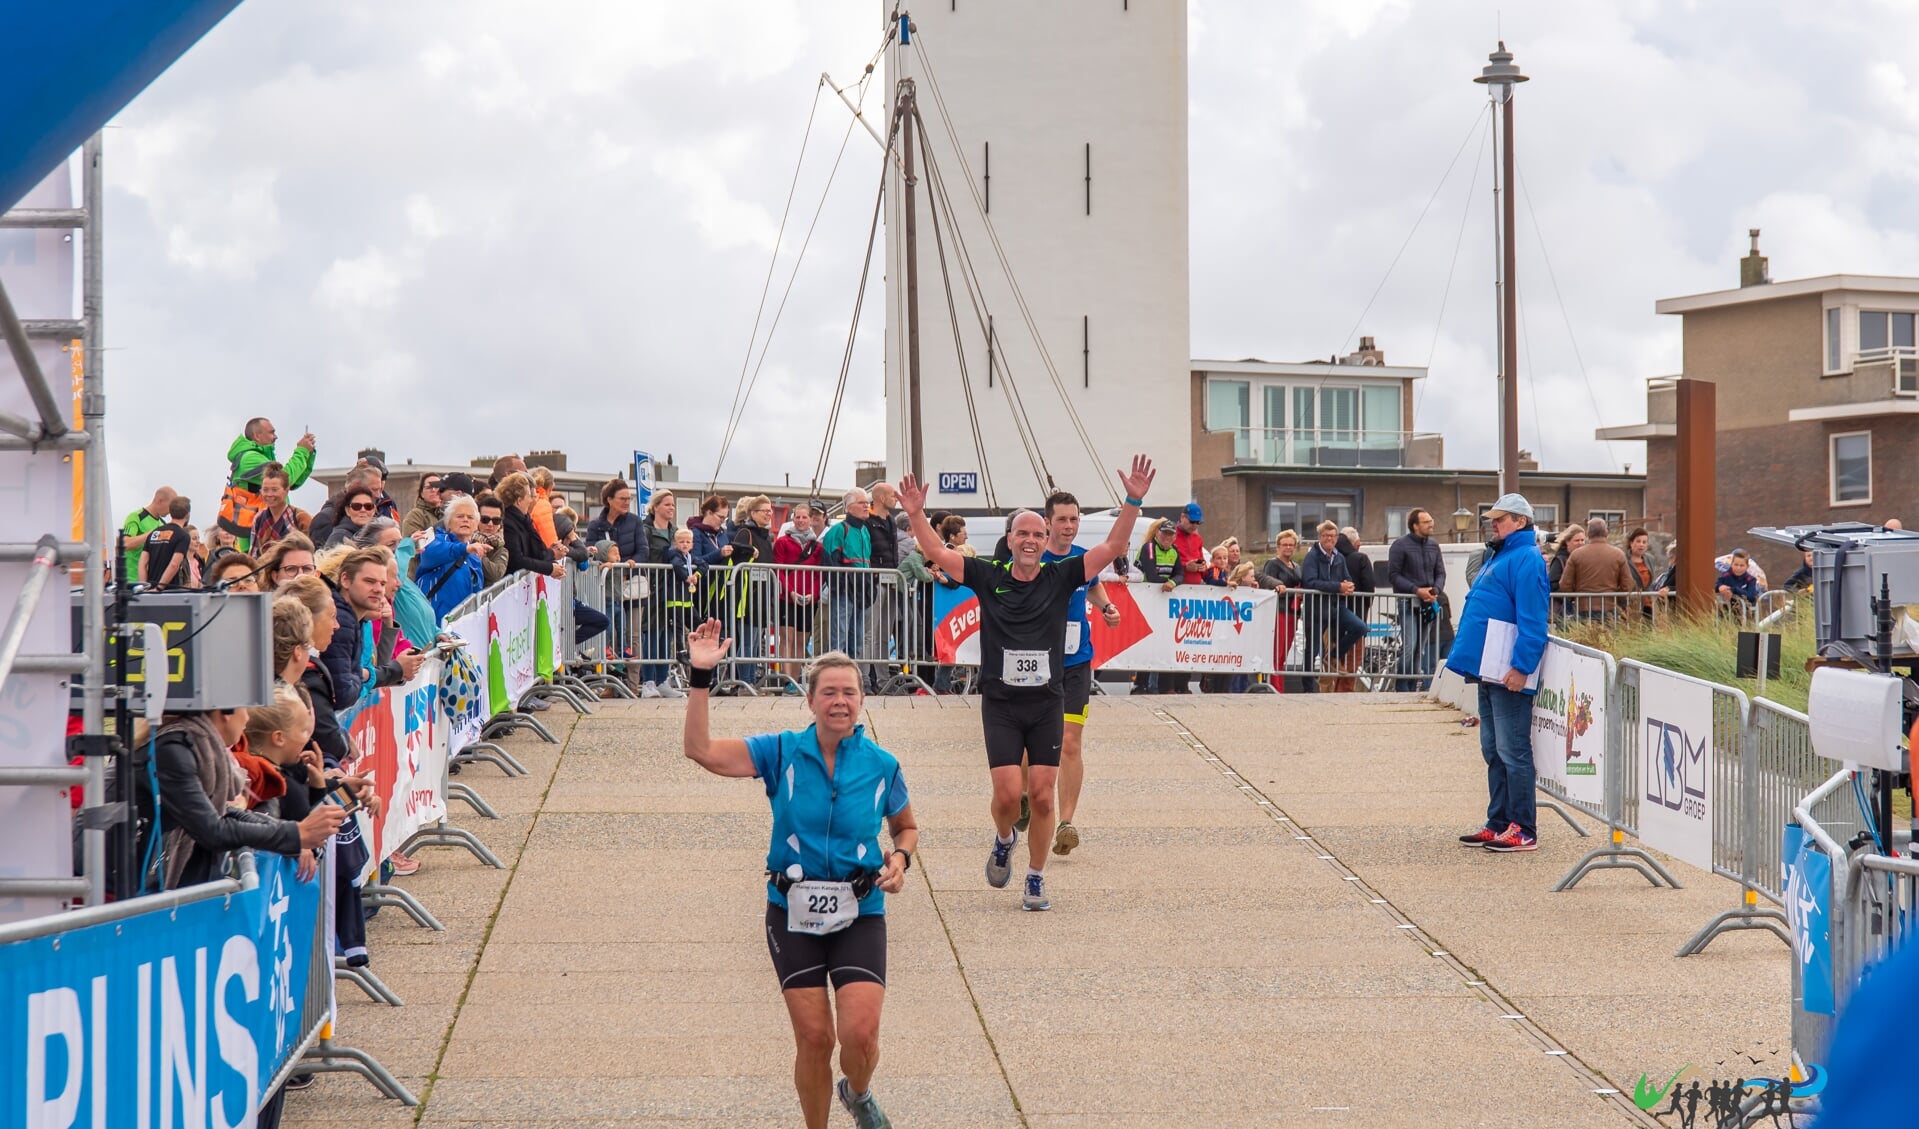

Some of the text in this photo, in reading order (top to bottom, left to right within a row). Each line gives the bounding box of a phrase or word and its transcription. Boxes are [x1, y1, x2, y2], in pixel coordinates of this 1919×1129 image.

[941, 474, 975, 489] OPEN
[1168, 598, 1253, 622] RUNNING
[1174, 606, 1215, 644] Center
[1016, 660, 1038, 672] 338
[1175, 651, 1243, 667] We are running
[1684, 797, 1706, 821] GROEP
[808, 894, 838, 914] 223
